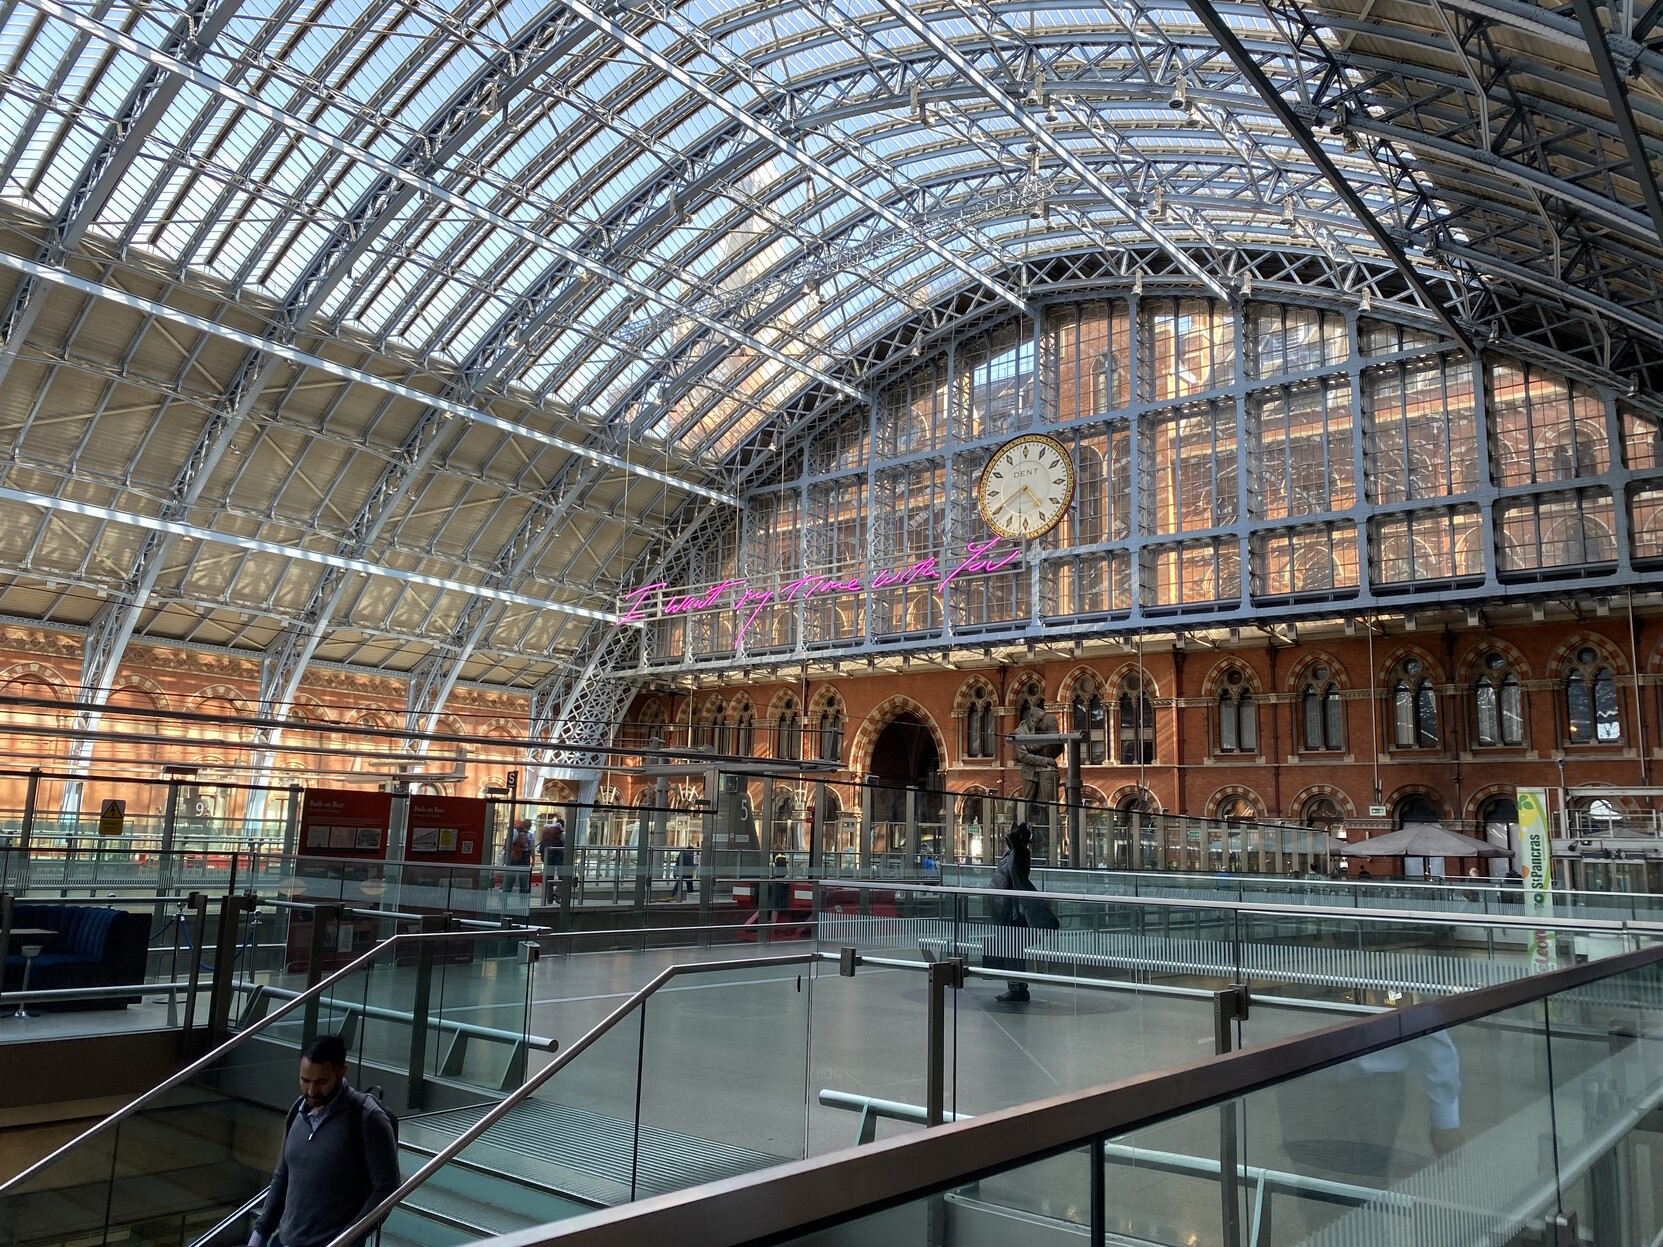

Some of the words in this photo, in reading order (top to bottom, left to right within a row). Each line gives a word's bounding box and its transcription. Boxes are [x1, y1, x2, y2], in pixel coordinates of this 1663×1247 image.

[1013, 467, 1039, 479] DENT
[617, 582, 667, 627] I
[664, 579, 747, 614] want
[734, 588, 774, 650] my
[781, 573, 861, 603] time
[871, 556, 941, 589] with
[508, 772, 516, 784] S
[195, 802, 204, 817] 9
[740, 799, 749, 821] 5
